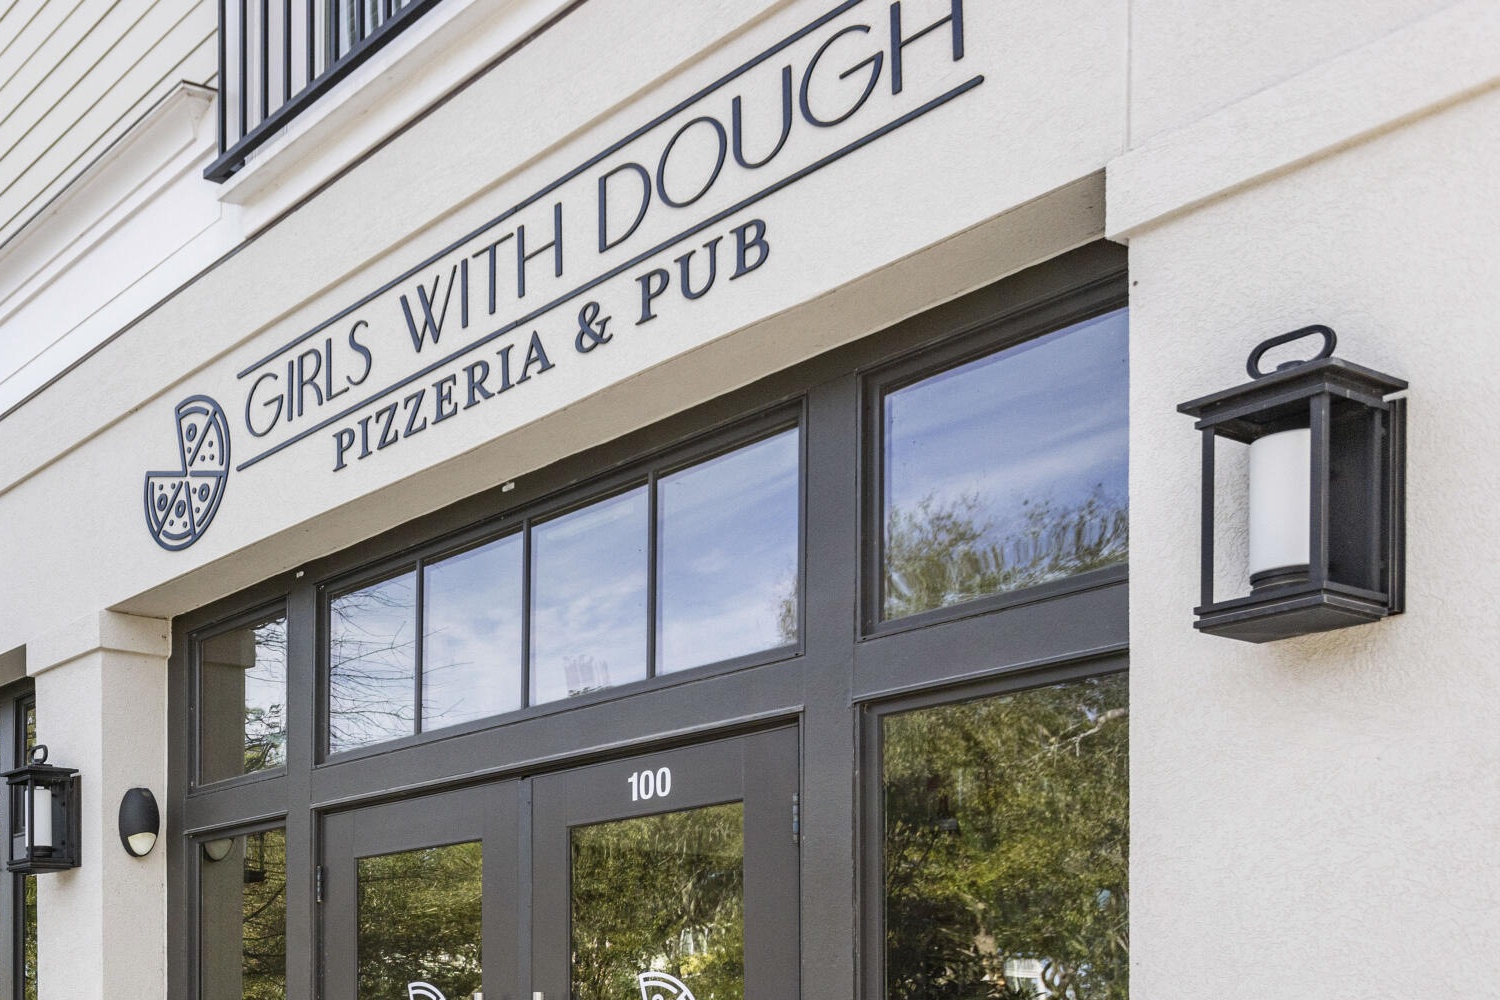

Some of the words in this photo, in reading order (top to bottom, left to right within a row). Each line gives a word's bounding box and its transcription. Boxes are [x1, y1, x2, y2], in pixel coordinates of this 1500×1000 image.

[245, 320, 372, 437] GIRLS
[400, 202, 562, 353] WITH
[599, 0, 964, 253] DOUGH
[332, 330, 555, 472] PIZZERIA
[575, 301, 613, 353] &
[635, 219, 770, 325] PUB
[627, 767, 672, 801] 100
